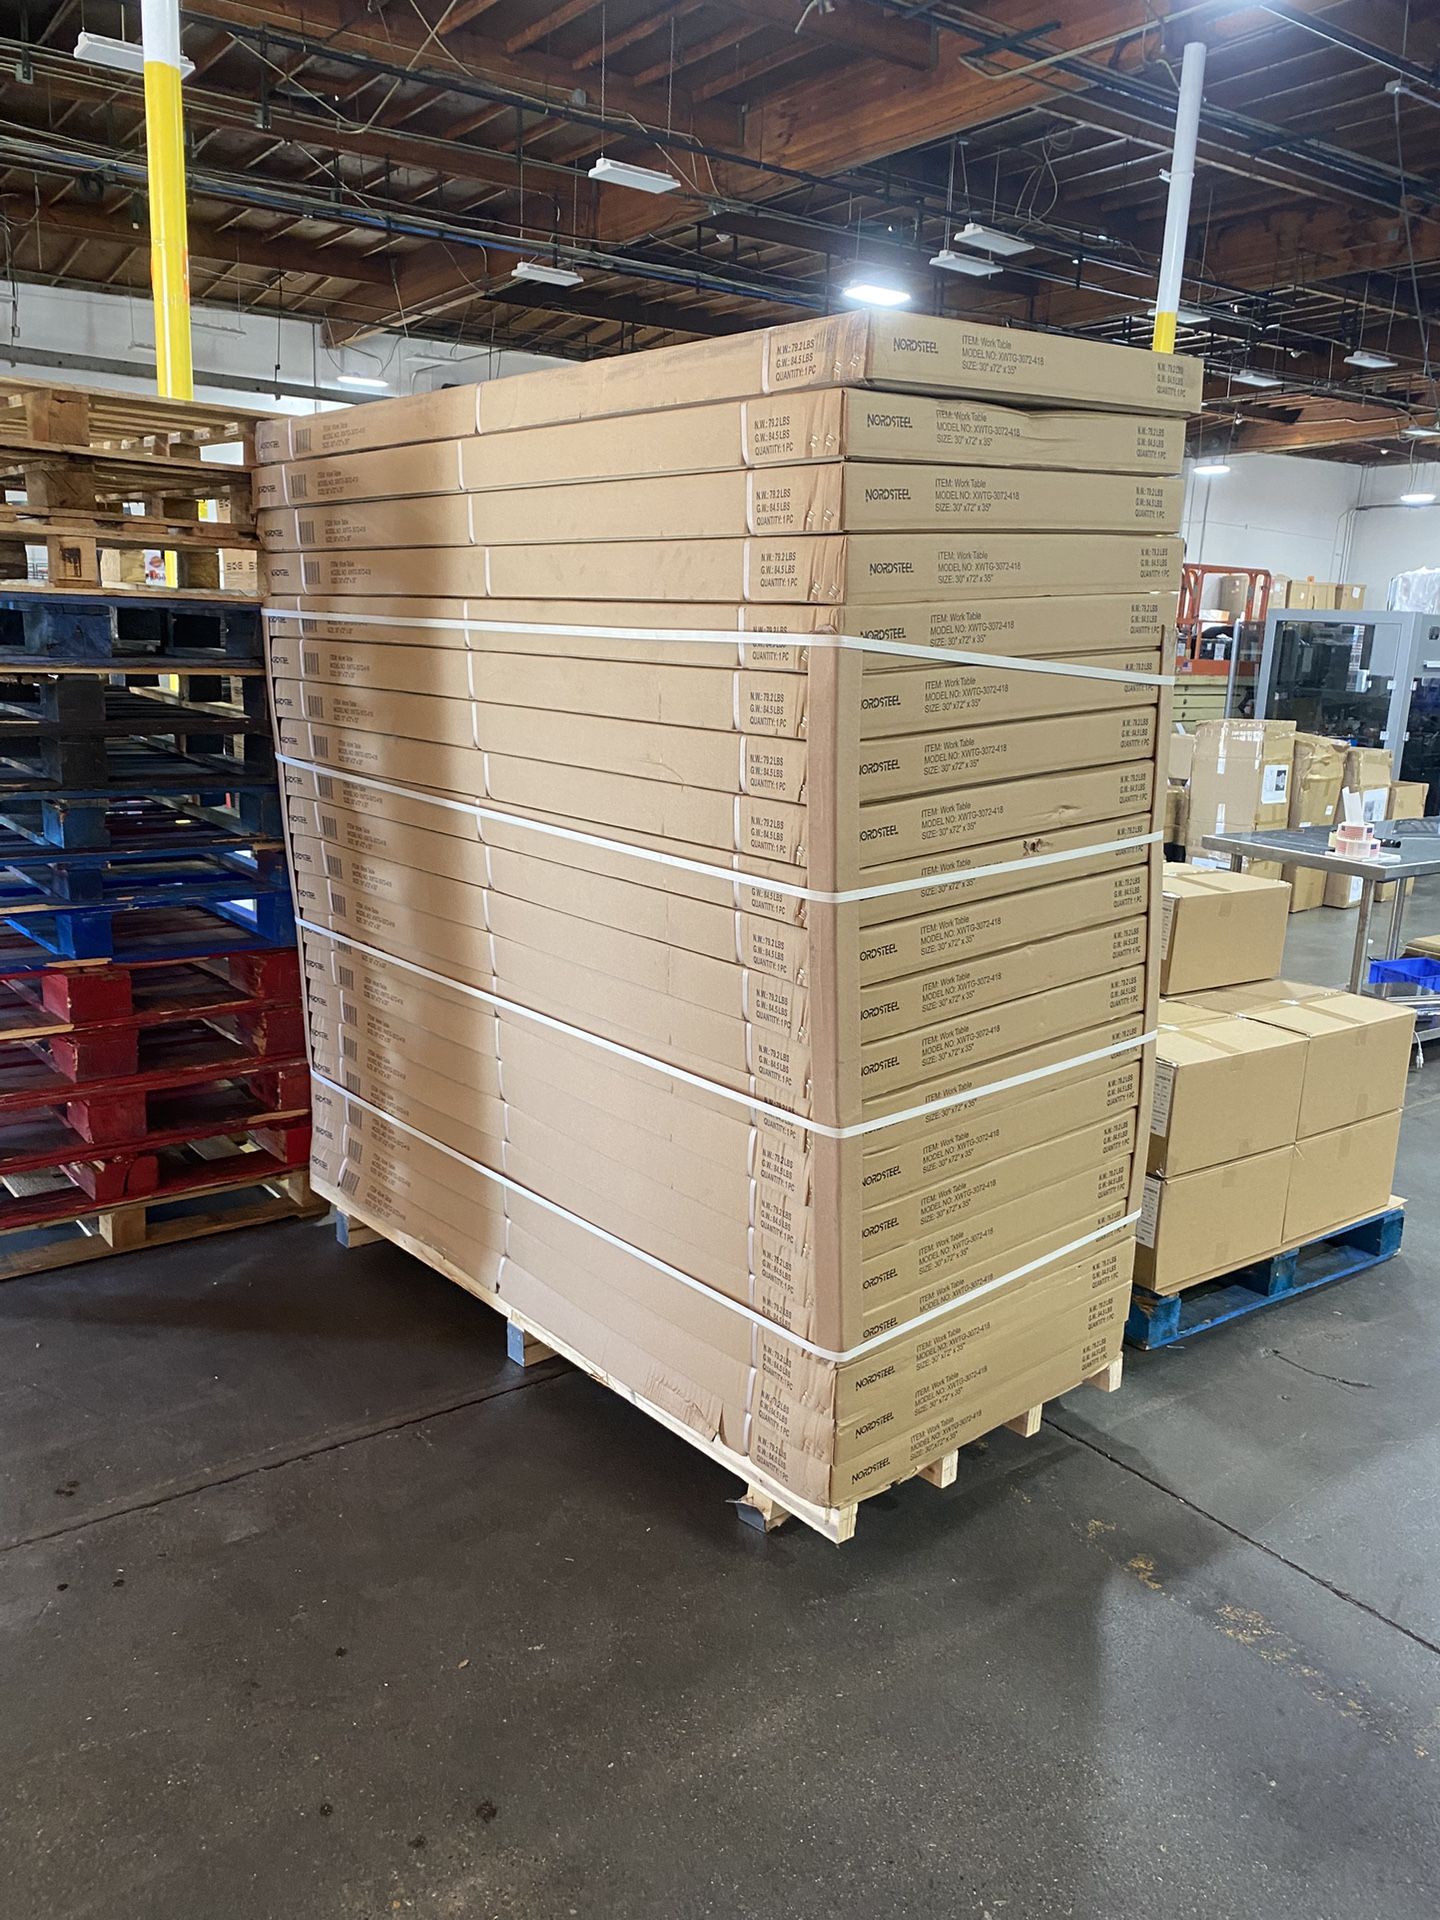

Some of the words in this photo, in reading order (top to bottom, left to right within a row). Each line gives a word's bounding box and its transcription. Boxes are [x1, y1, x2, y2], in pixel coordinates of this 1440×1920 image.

[791, 341, 801, 352] 79.2
[802, 339, 814, 350] LBS
[893, 337, 938, 354] NORDSTEEL
[962, 335, 978, 345] ITEM:
[980, 337, 995, 347] Work
[996, 339, 1011, 349] Table
[802, 352, 813, 363] LBS
[962, 348, 986, 359] MODEL
[986, 350, 997, 360] NO:
[776, 366, 803, 382] QUANTITY:
[808, 363, 816, 375] PC
[962, 360, 978, 371] SIZE:
[867, 413, 912, 428] NORDSTEEL
[936, 479, 951, 487] ITEM:
[954, 479, 969, 487] Work
[970, 480, 986, 488] Table
[865, 488, 911, 502] NORDSTEEL
[935, 490, 959, 499] MODEL
[959, 491, 971, 499] NO:
[935, 502, 951, 511] SIZE:
[774, 552, 784, 561] 79.2
[785, 552, 795, 561] LBS
[785, 564, 794, 573] LBS
[869, 562, 914, 575] NORDSTEEL
[760, 577, 785, 587] QUANTITY:
[790, 576, 797, 586] PC
[931, 613, 946, 623] ITEM:
[949, 612, 964, 622] Work
[966, 611, 981, 620] Table
[930, 625, 954, 635] MODEL
[954, 624, 966, 633] NO:
[930, 637, 946, 647] SIZE:
[860, 695, 901, 710] ORDSTEEL
[924, 743, 940, 753] ITEM:
[943, 740, 958, 750] Work
[959, 737, 974, 747] Table
[763, 755, 772, 765] 79.2
[773, 756, 783, 766] LBS
[924, 751, 948, 763] MODEL
[948, 750, 959, 760] NO:
[773, 768, 783, 778] LBS
[924, 764, 940, 775] SIZE:
[750, 778, 774, 789] QUANTITY:
[778, 781, 785, 791] PC
[859, 825, 898, 841] ORDSTEEL
[920, 923, 935, 934] ITEM:
[938, 919, 953, 930] Work
[954, 915, 969, 926] Table
[920, 931, 943, 945] MODEL
[943, 928, 954, 939] NO:
[859, 943, 898, 961] ORDSTEEL
[920, 944, 936, 956] SIZE:
[921, 1034, 936, 1046] ITEM:
[939, 1029, 953, 1041] Work
[954, 1024, 969, 1036] Table
[921, 1042, 944, 1057] MODEL
[944, 1038, 955, 1050] NO:
[780, 1052, 789, 1063] LBS
[921, 1054, 936, 1067] SIZE:
[780, 1063, 789, 1074] LBS
[759, 1066, 781, 1082] QUANTITY:
[785, 1076, 791, 1086] PC
[921, 1193, 934, 1206] ITEM:
[937, 1187, 951, 1199] Work
[952, 1182, 966, 1194] Table
[920, 1199, 942, 1215] MODEL
[942, 1195, 952, 1207] NO:
[920, 1212, 935, 1225] SIZE:
[862, 1217, 899, 1238] ORDSTEEL
[862, 1268, 898, 1290] ORDSTEEL
[862, 1317, 898, 1338] ORDSTEEL
[916, 1340, 930, 1353] ITEM:
[932, 1333, 945, 1346] Work
[947, 1327, 960, 1340] Table
[916, 1344, 937, 1361] MODEL
[937, 1340, 947, 1352] NO:
[916, 1357, 930, 1371] SIZE:
[855, 1365, 896, 1391] NORDSTEEL
[855, 1411, 895, 1439] NORDSTEEL
[851, 1456, 891, 1484] NORDSTEEL
